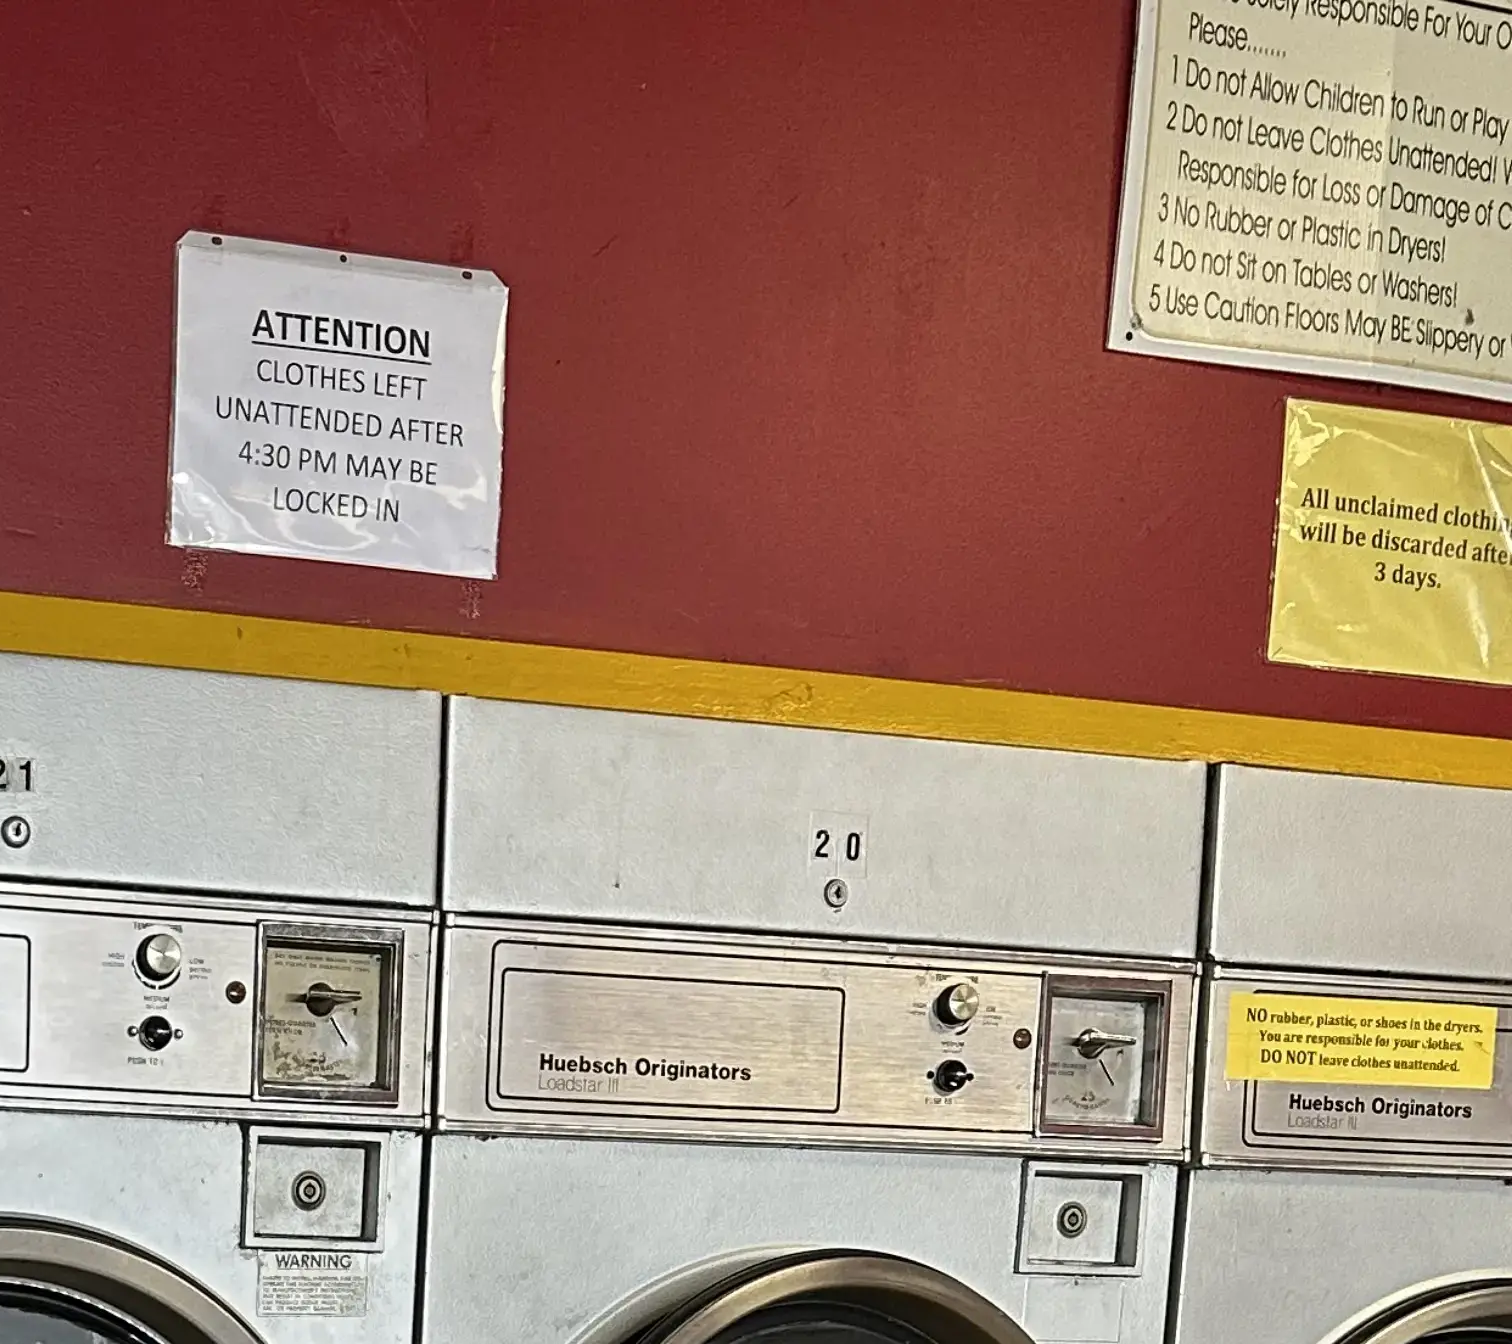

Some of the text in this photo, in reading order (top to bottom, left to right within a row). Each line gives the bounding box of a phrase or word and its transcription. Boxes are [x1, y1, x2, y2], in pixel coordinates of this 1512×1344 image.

[1424, 5, 1451, 38] For
[1456, 12, 1492, 47] Your
[1172, 54, 1510, 146] 1 Do not Allow Children to Run or Play
[1166, 101, 1178, 131] 2
[1182, 103, 1207, 136] Do
[1212, 114, 1243, 143] not
[1248, 115, 1304, 152] Leave
[1310, 126, 1383, 163] Clothes
[1178, 150, 1286, 195] Responsible
[1292, 169, 1317, 200] for
[1323, 172, 1361, 205] Loss
[1366, 184, 1386, 208] or
[1390, 182, 1470, 228] Damage
[1475, 199, 1494, 226] of
[1158, 192, 1446, 263] 3 No Rubber or Plastic in Dryers!
[1154, 239, 1457, 308] 4 Do not Sit on Tables or Washers!
[252, 310, 430, 357] ATTENTION
[1149, 284, 1506, 360] 5 Use Caution Floors May BE Slippery or
[257, 359, 427, 400] CLOTHES LEFT
[216, 395, 463, 447] UNATTENDED AFTER
[238, 441, 437, 485] 4:30 PM MAY BE
[273, 487, 399, 522] LOCKED IN
[1301, 488, 1329, 509] All
[1335, 495, 1438, 524] unclaimed
[1300, 522, 1337, 544] will
[1343, 525, 1366, 546] be
[1372, 529, 1467, 560] discarded
[1374, 562, 1441, 592] 3 days.
[815, 829, 860, 861] 20
[1247, 1008, 1483, 1035] NO rubber, plastic, or shoes in the dryers.
[1259, 1030, 1281, 1042] You
[1283, 1033, 1303, 1043] are
[1306, 1033, 1373, 1048] responsible
[1393, 1039, 1420, 1051] your
[539, 1053, 752, 1081] Huebsch Originators
[1260, 1049, 1460, 1072] DO NOT leave clothes unattended.
[538, 1074, 619, 1094] Loadstar III
[1288, 1114, 1343, 1130] Loadstar
[1289, 1093, 1472, 1119] Huebsch Originators
[275, 1254, 352, 1269] WARNING
